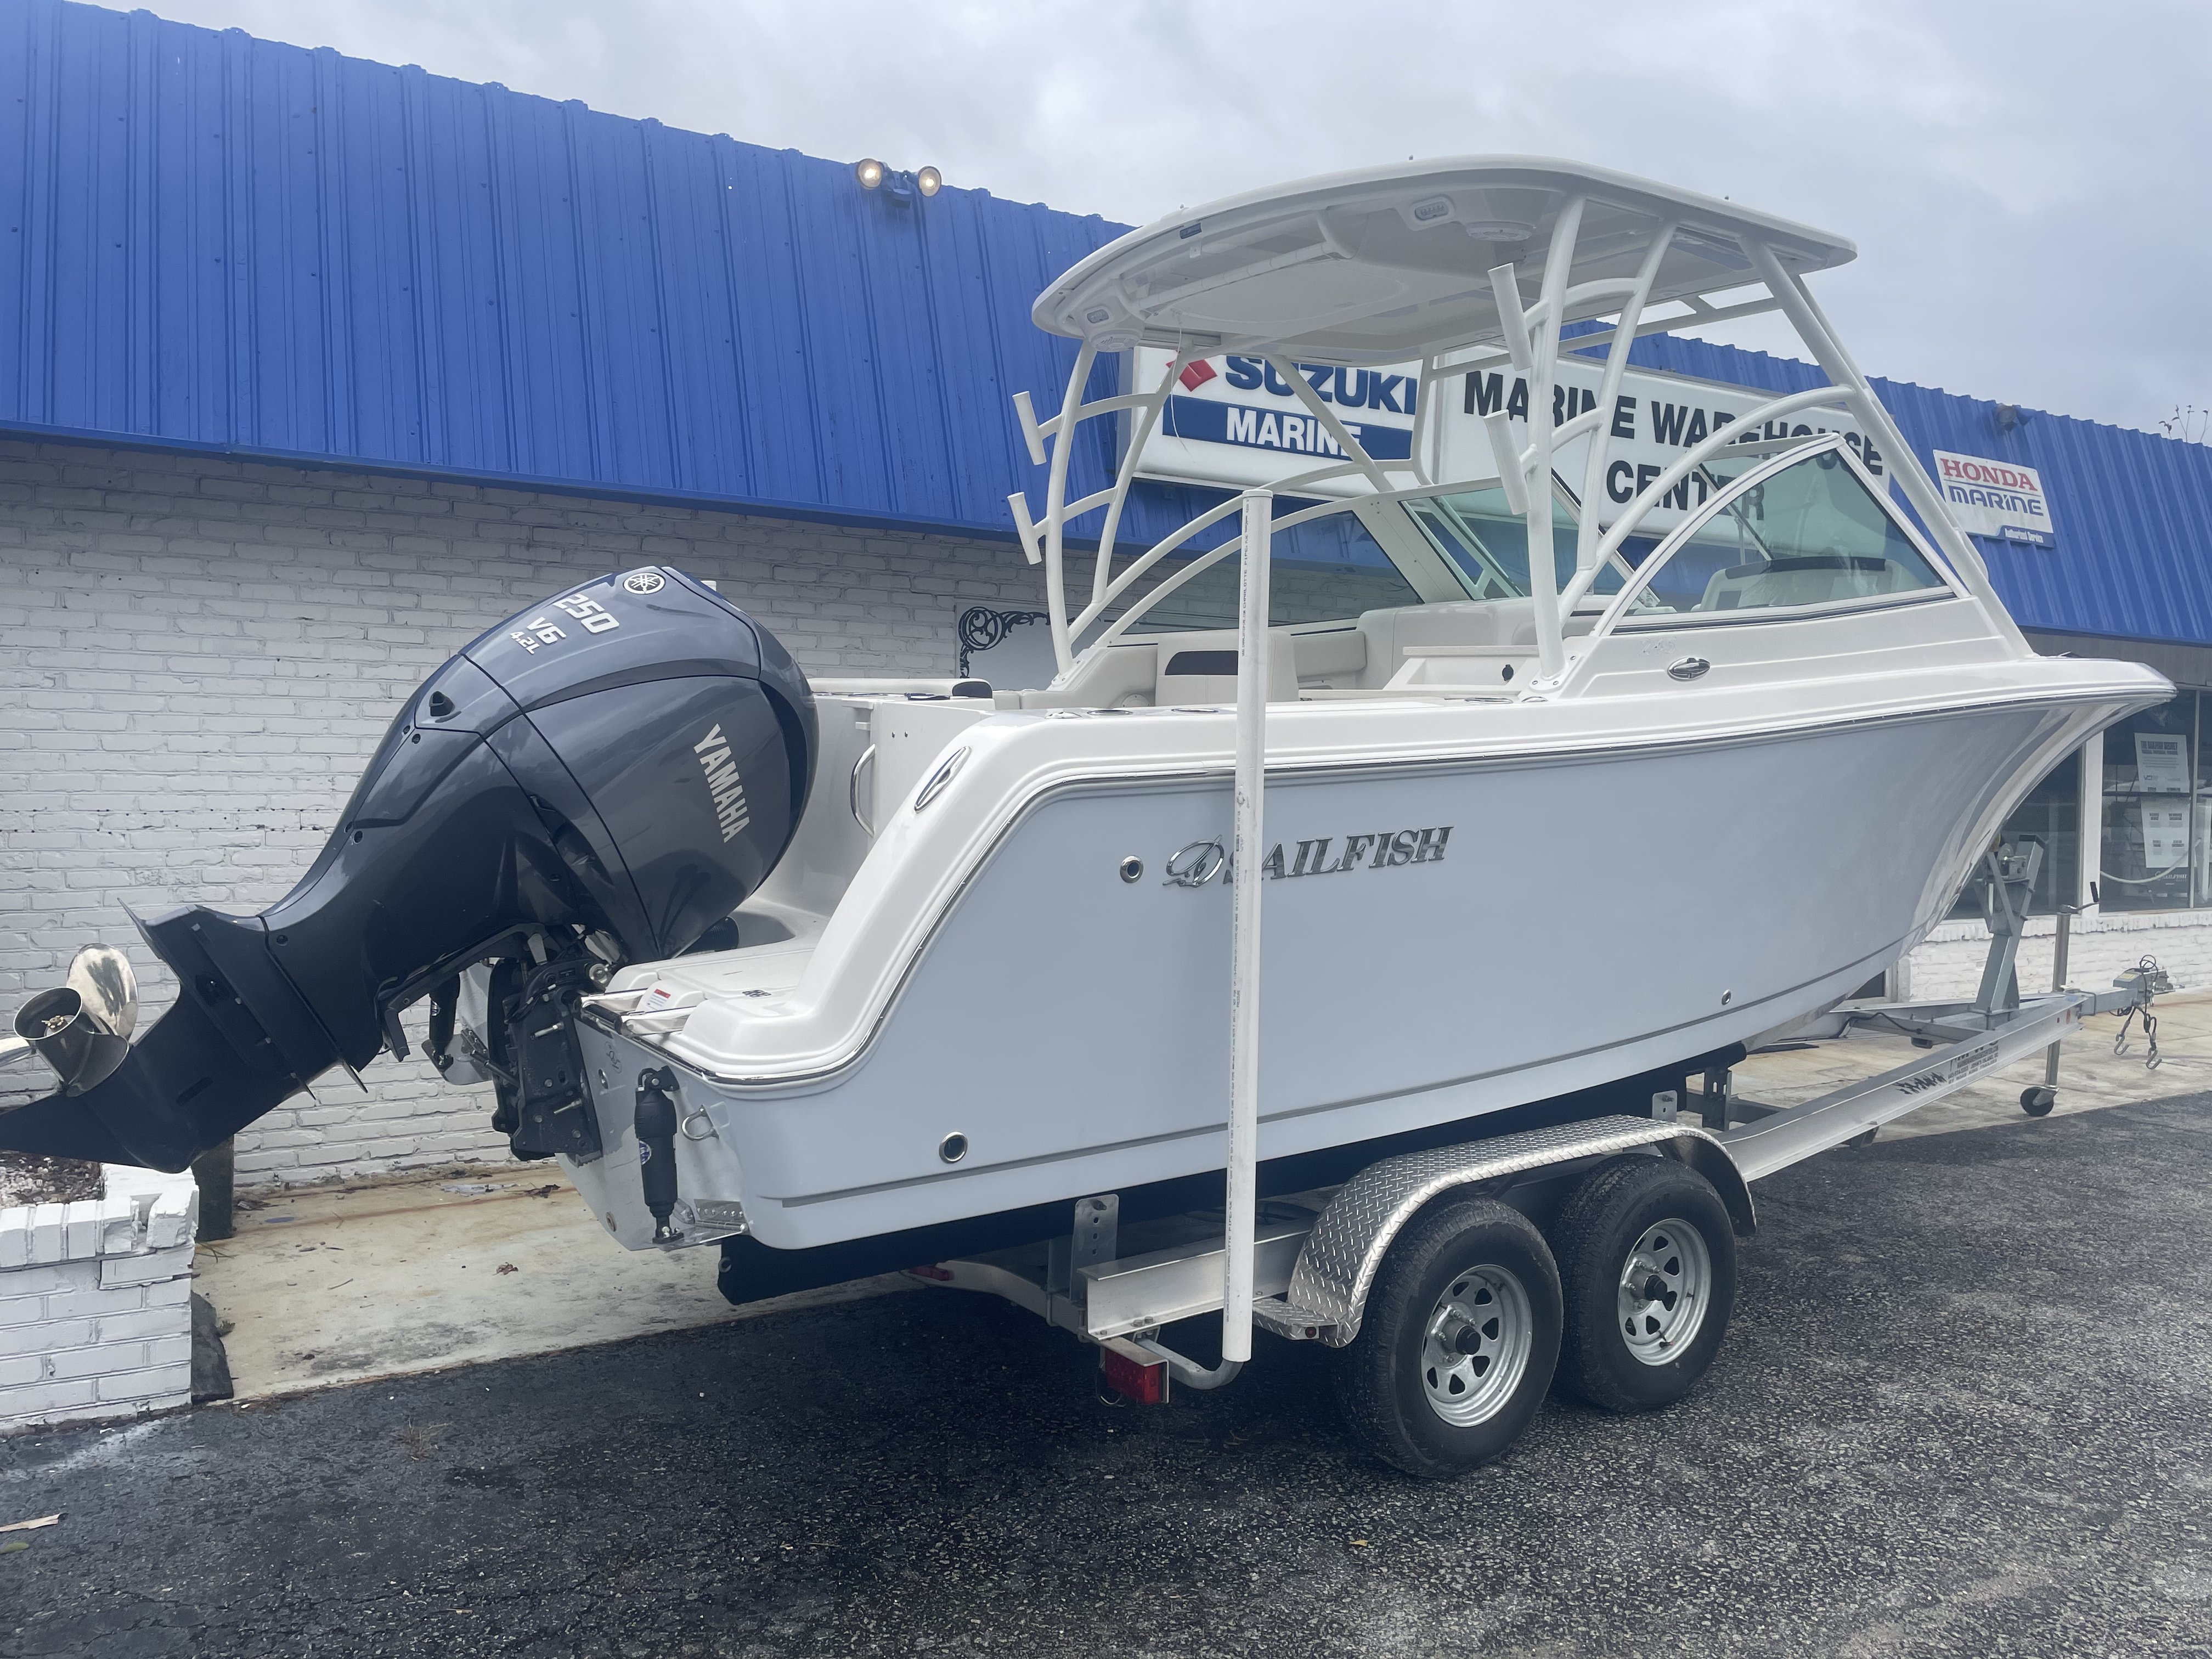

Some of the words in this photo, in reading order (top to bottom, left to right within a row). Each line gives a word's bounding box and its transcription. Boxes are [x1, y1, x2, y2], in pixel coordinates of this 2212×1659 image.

[1226, 356, 1418, 415] SUZUKI
[1940, 458, 2038, 491] HONDA
[1948, 486, 2044, 516] MARINE
[527, 617, 567, 644] V6
[552, 594, 619, 633] 250
[510, 631, 540, 654] 4.2L
[693, 723, 751, 843] YAMAHA
[1223, 825, 1454, 884] AILFISH
